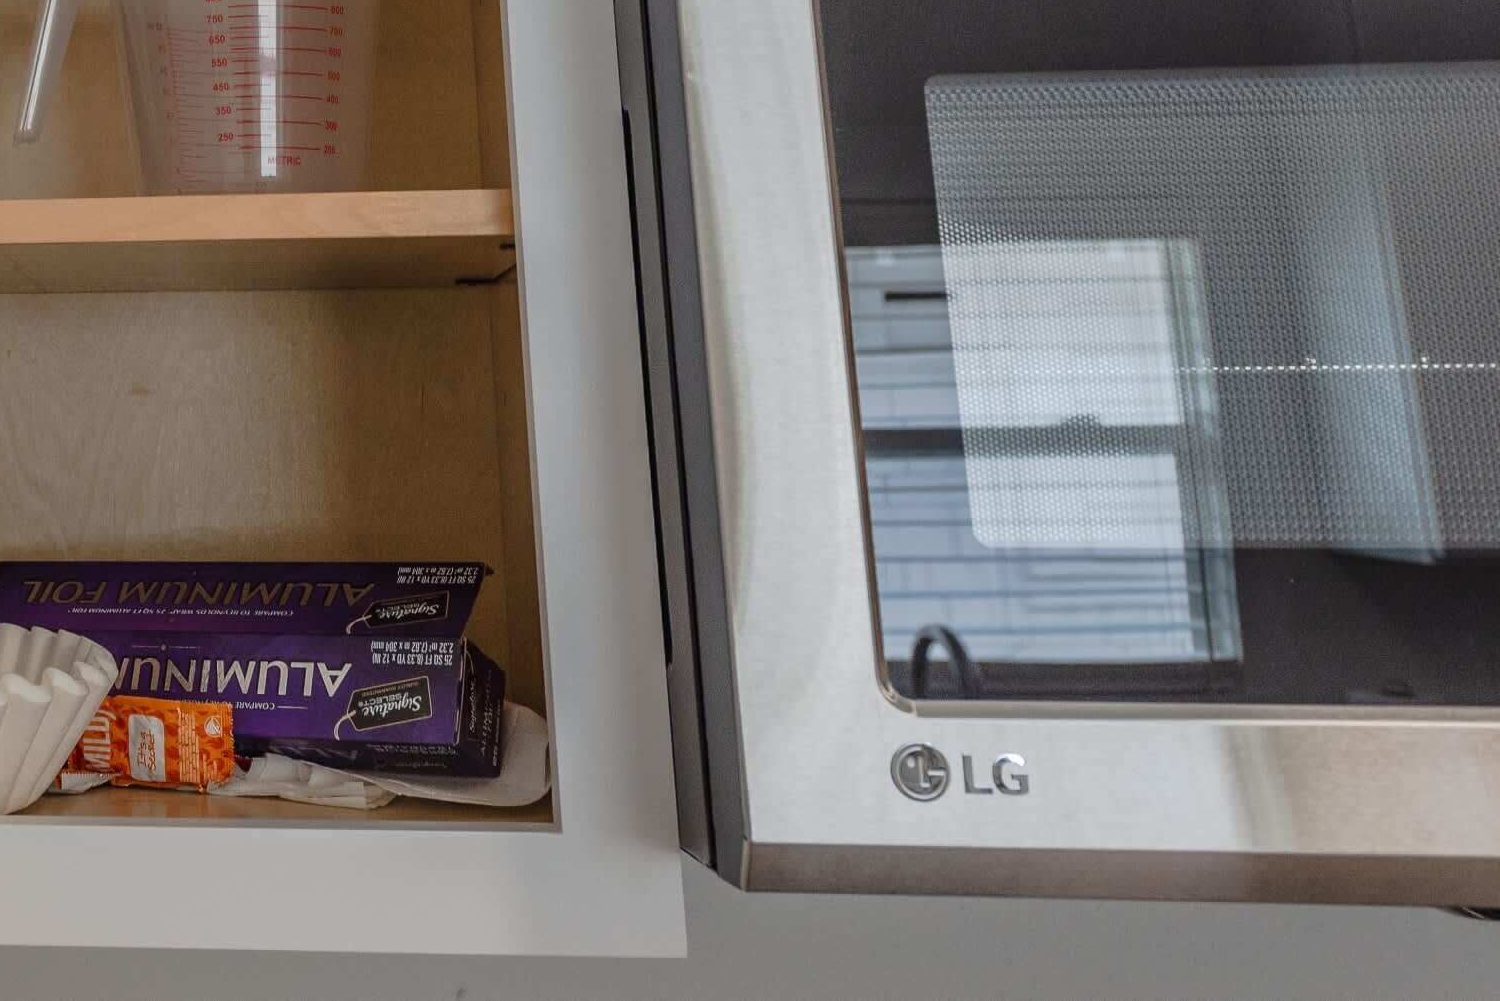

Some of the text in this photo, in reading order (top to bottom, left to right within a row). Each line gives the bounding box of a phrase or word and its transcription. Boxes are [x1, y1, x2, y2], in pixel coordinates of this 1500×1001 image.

[207, 14, 224, 24] 750
[209, 34, 226, 44] 650
[211, 58, 228, 68] 550
[212, 82, 229, 92] 450
[215, 106, 232, 116] 350
[218, 132, 234, 142] 250
[23, 581, 108, 604] FOIL
[118, 581, 376, 607] ALUMINUM
[380, 601, 439, 618] Signature
[439, 642, 454, 652] 2.32
[381, 653, 390, 665] 12
[424, 654, 433, 665] FT
[433, 654, 442, 665] SQ
[235, 702, 275, 710] COMPARE
[362, 692, 422, 718] Signature
[961, 752, 1030, 796] LG
